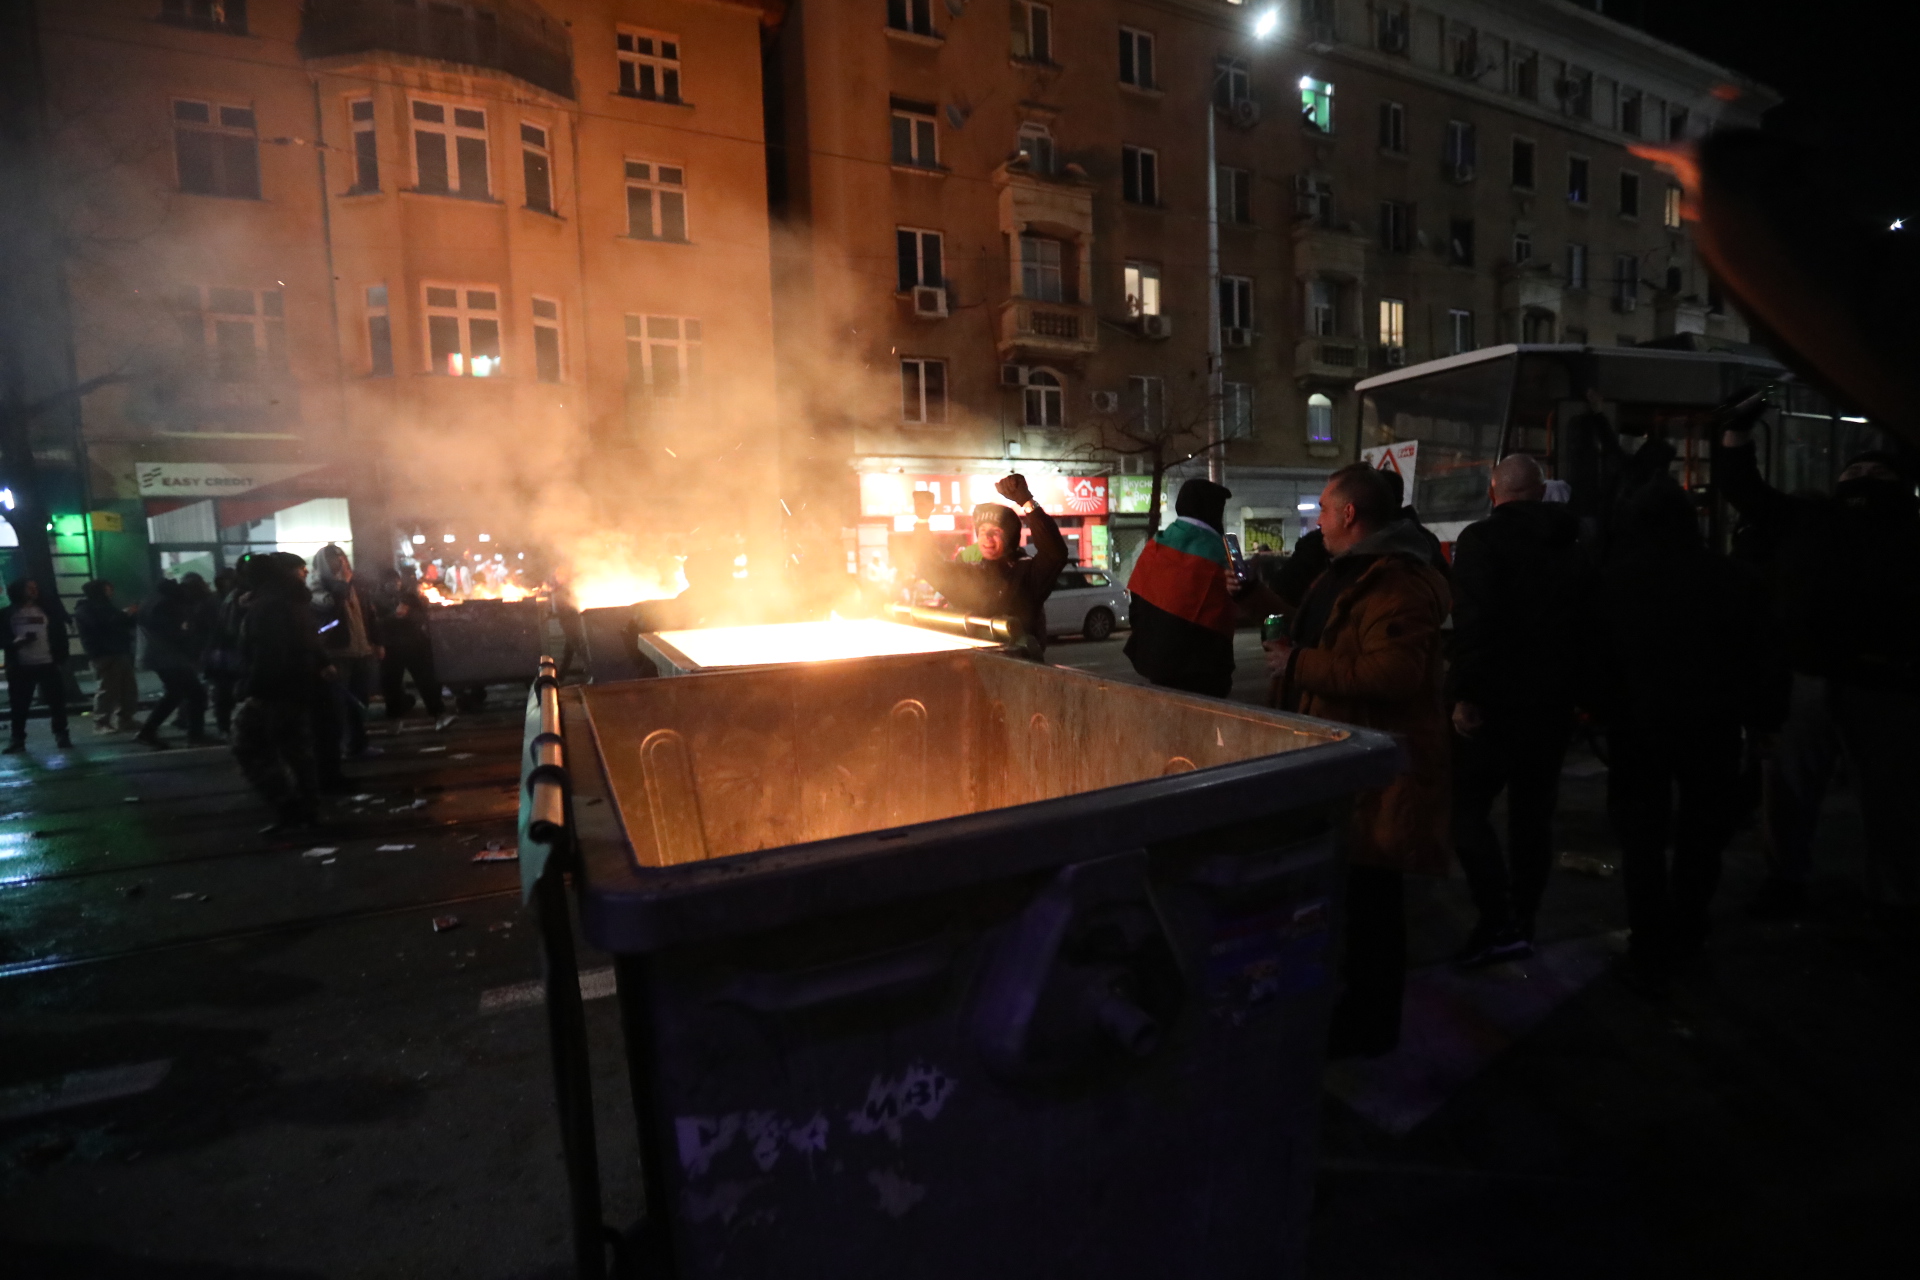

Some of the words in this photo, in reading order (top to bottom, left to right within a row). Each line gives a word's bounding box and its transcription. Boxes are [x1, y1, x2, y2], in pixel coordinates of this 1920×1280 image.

[161, 478, 200, 487] EASY
[205, 478, 253, 487] CREDIT
[1134, 490, 1168, 505] Вкуо
